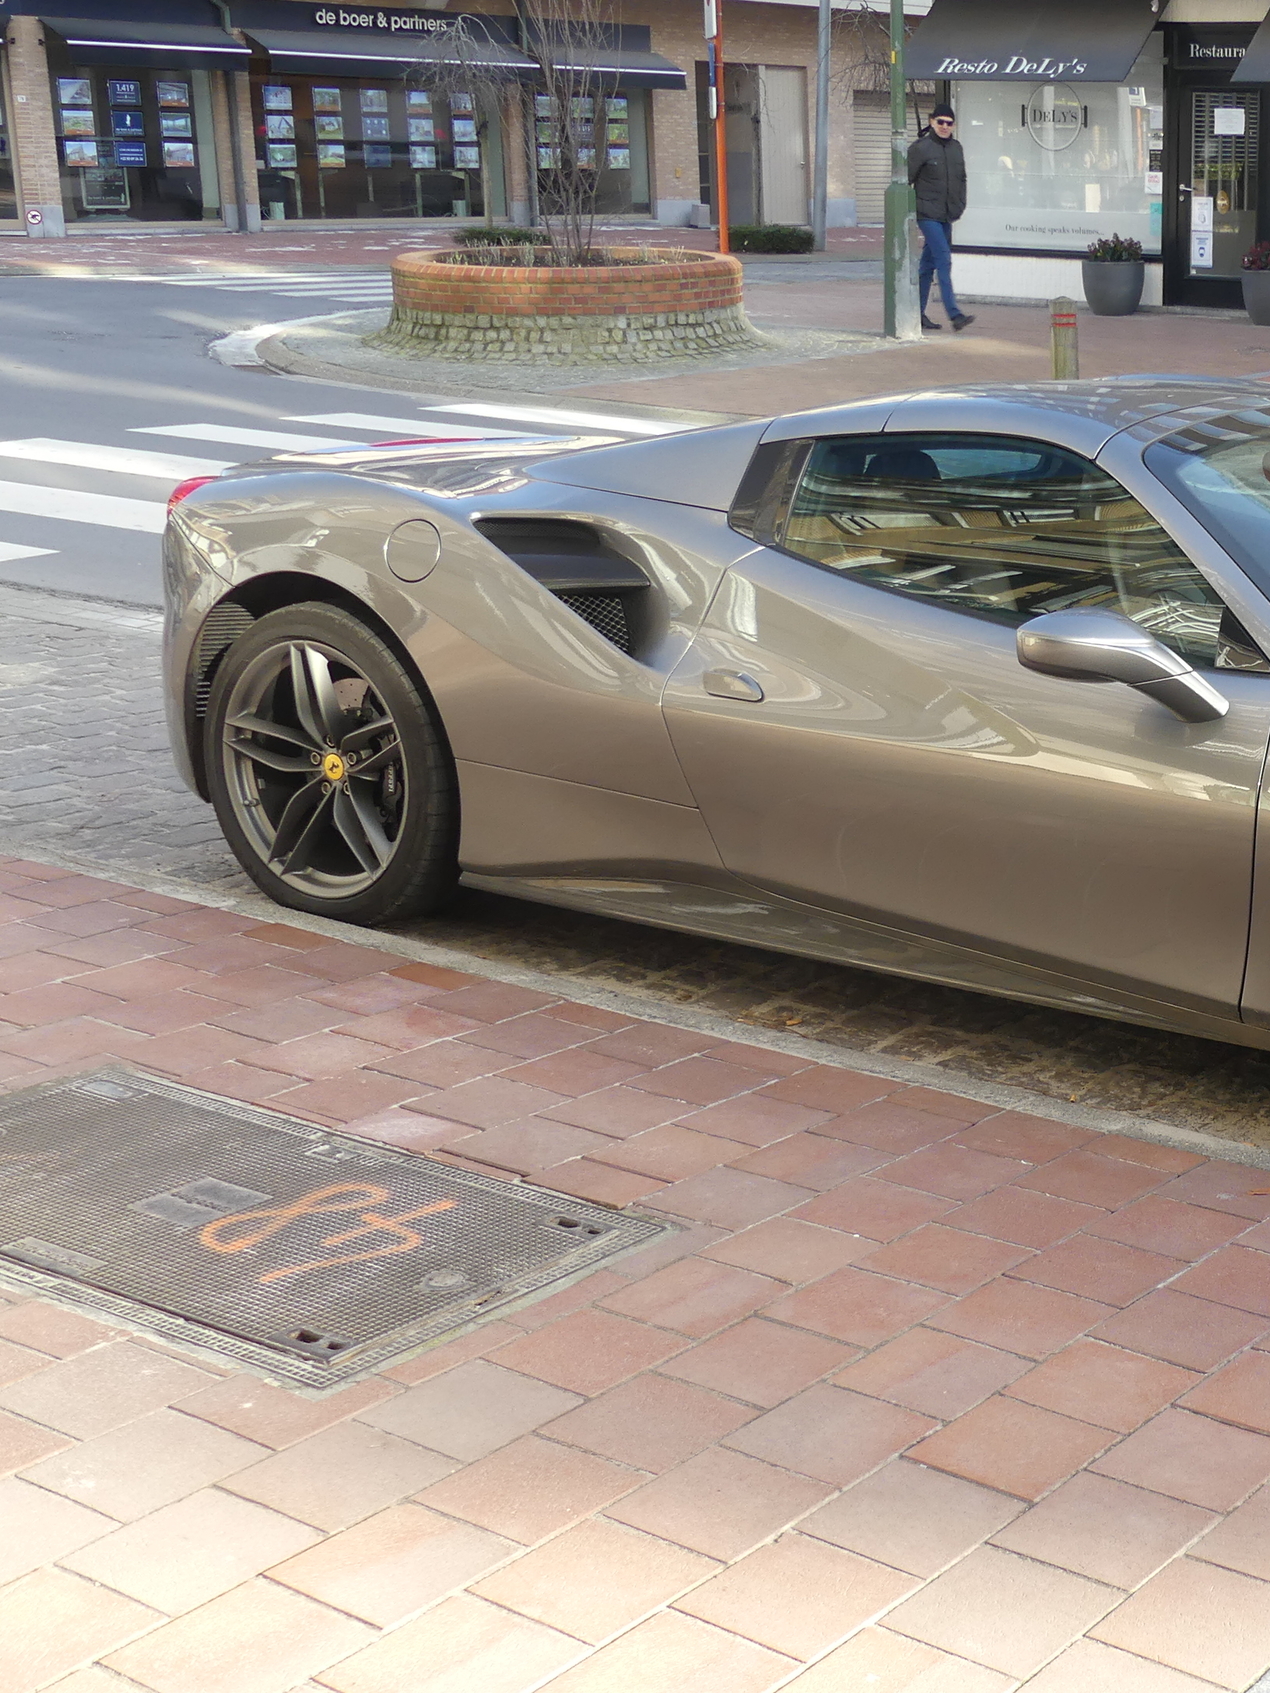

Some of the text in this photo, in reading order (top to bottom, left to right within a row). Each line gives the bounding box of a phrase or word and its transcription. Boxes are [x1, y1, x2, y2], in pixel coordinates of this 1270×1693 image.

[315, 8, 448, 31] de boer & partners
[934, 55, 1088, 78] Resto DeLy's
[1005, 223, 1019, 232] Our
[1019, 224, 1046, 234] cooking
[1047, 225, 1070, 235] speaks
